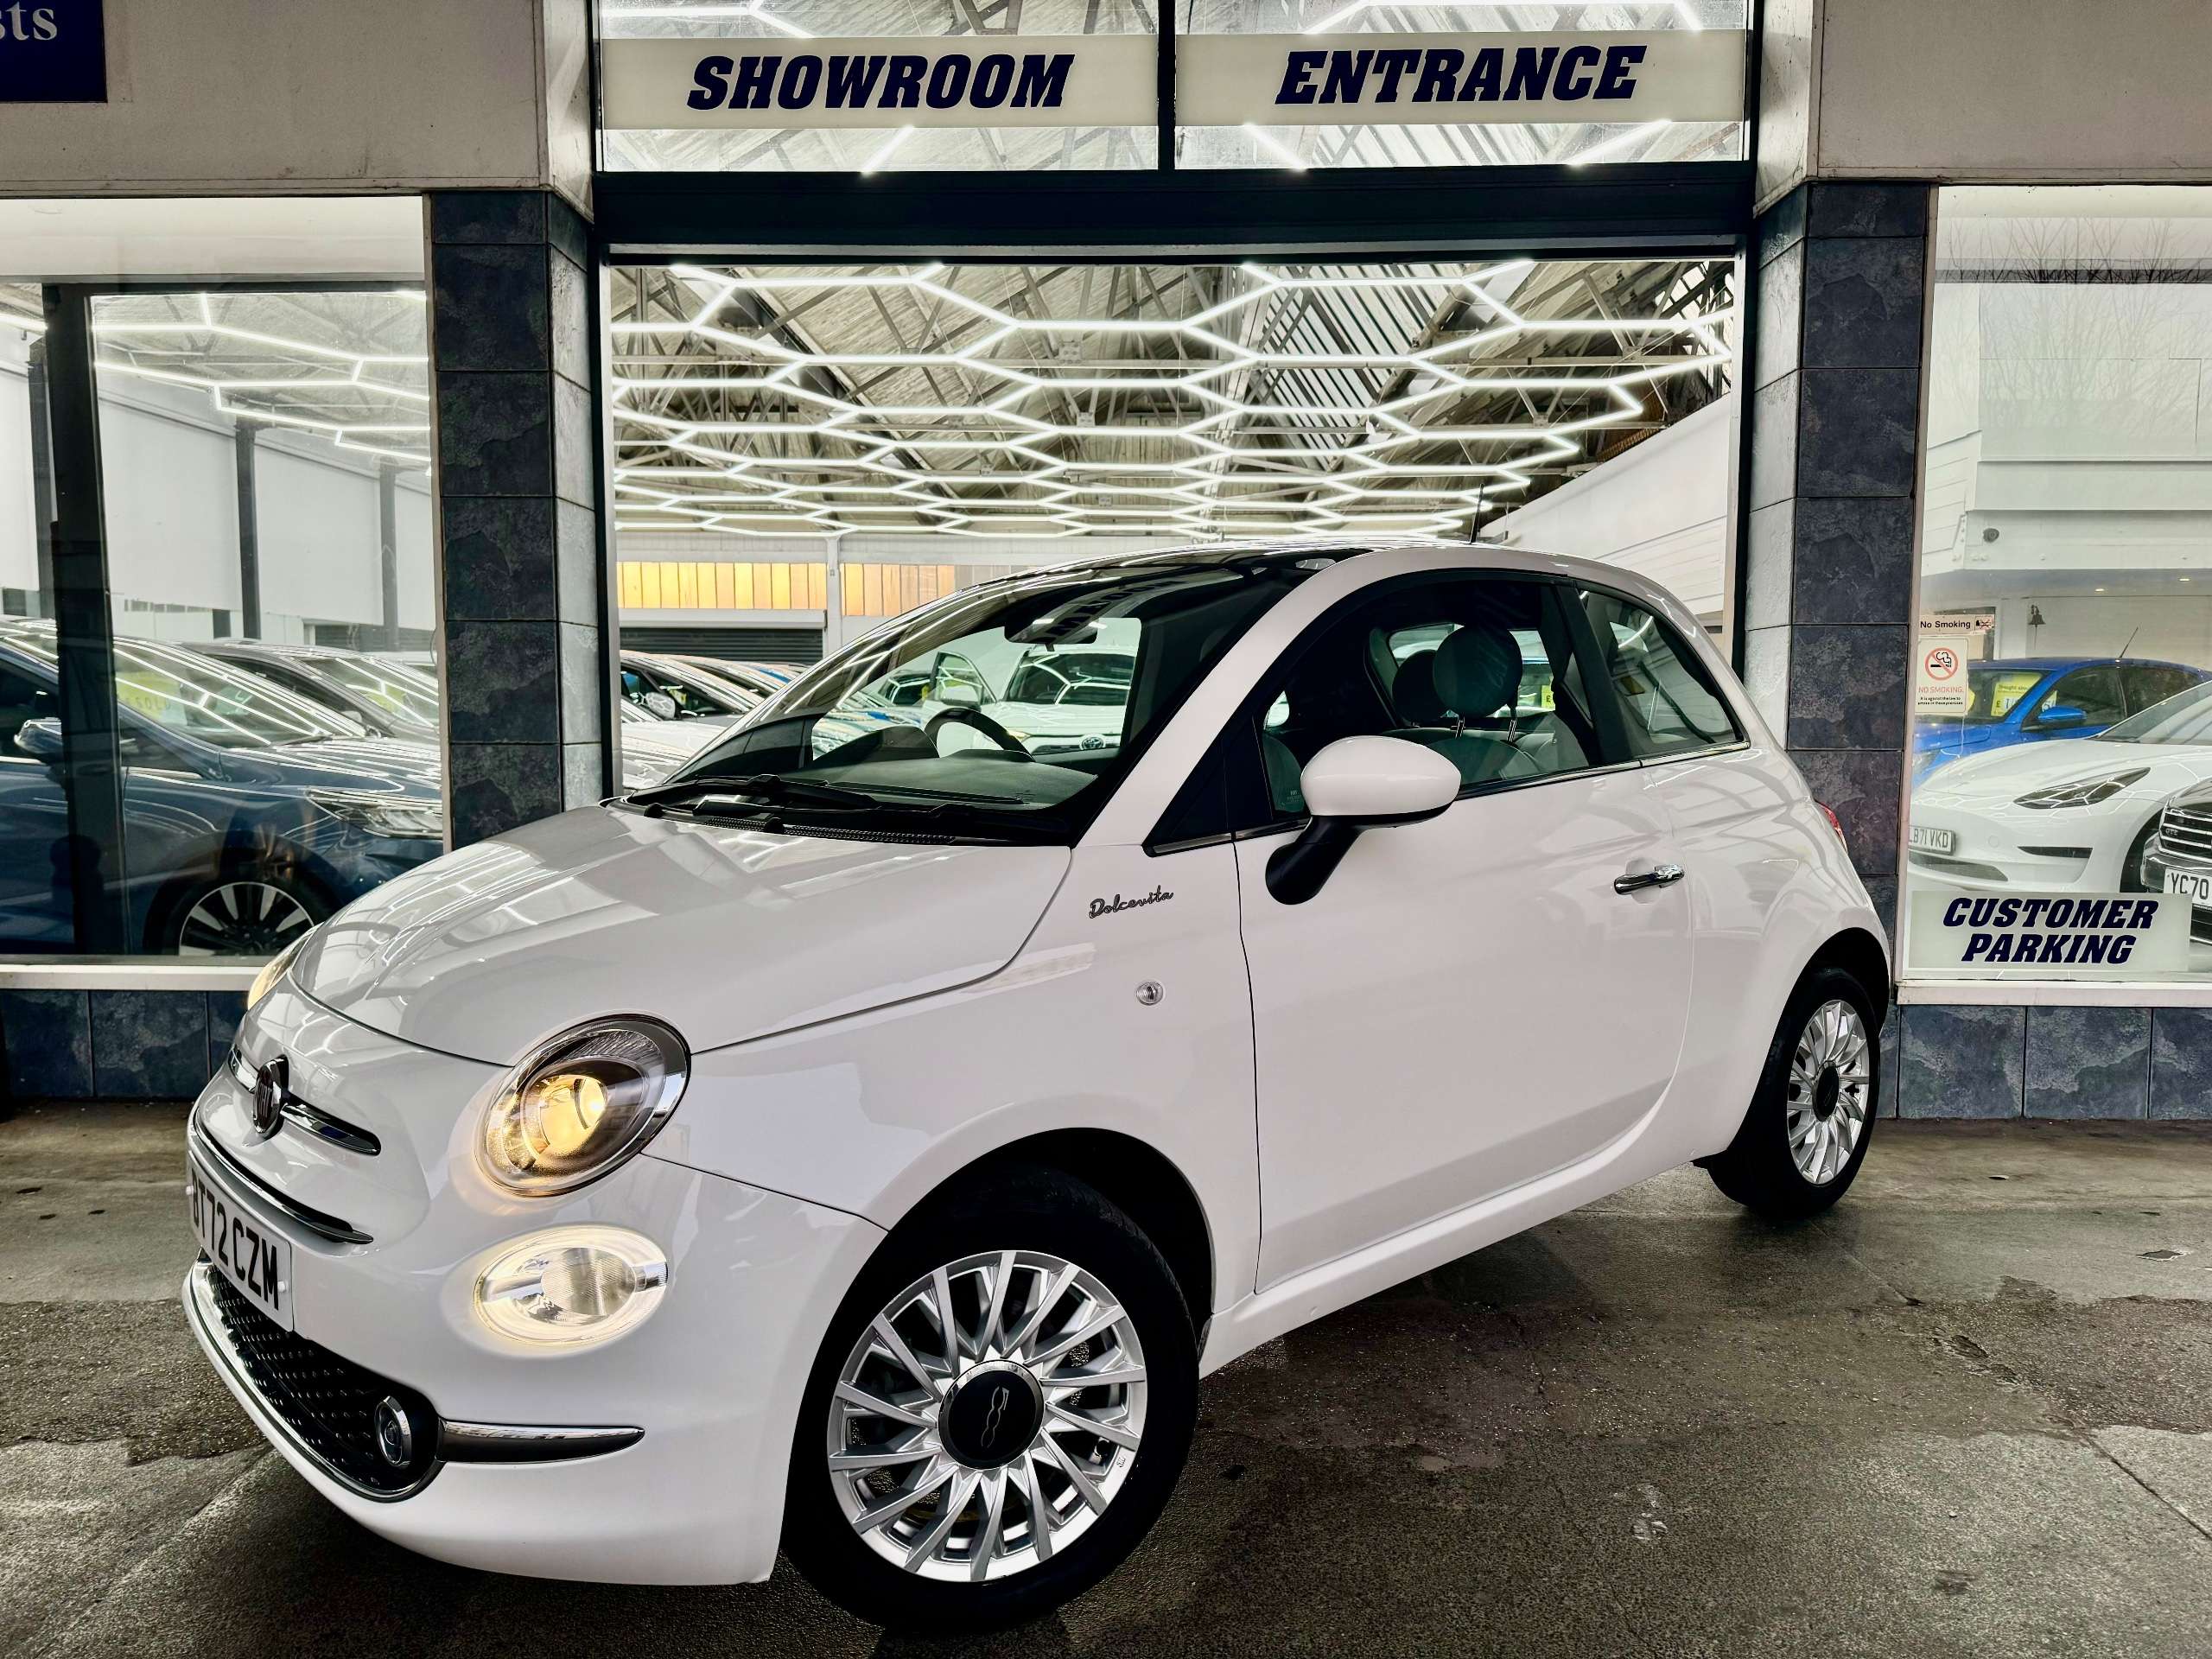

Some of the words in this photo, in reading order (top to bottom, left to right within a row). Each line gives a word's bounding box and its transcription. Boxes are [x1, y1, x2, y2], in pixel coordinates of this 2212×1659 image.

[0, 2, 58, 41] ts
[687, 54, 1075, 111] SHOWROOM
[1274, 45, 1647, 105] ENTRANCE
[1936, 620, 1971, 630] Smoking
[1929, 830, 1948, 849] VKD
[1089, 884, 1174, 919] Dolcevita
[2171, 872, 2209, 900] YC70
[1943, 898, 2158, 929] CUSTOMER
[1961, 933, 2137, 964] PARKING
[192, 1168, 229, 1267] BT72
[232, 1217, 288, 1312] CZM
